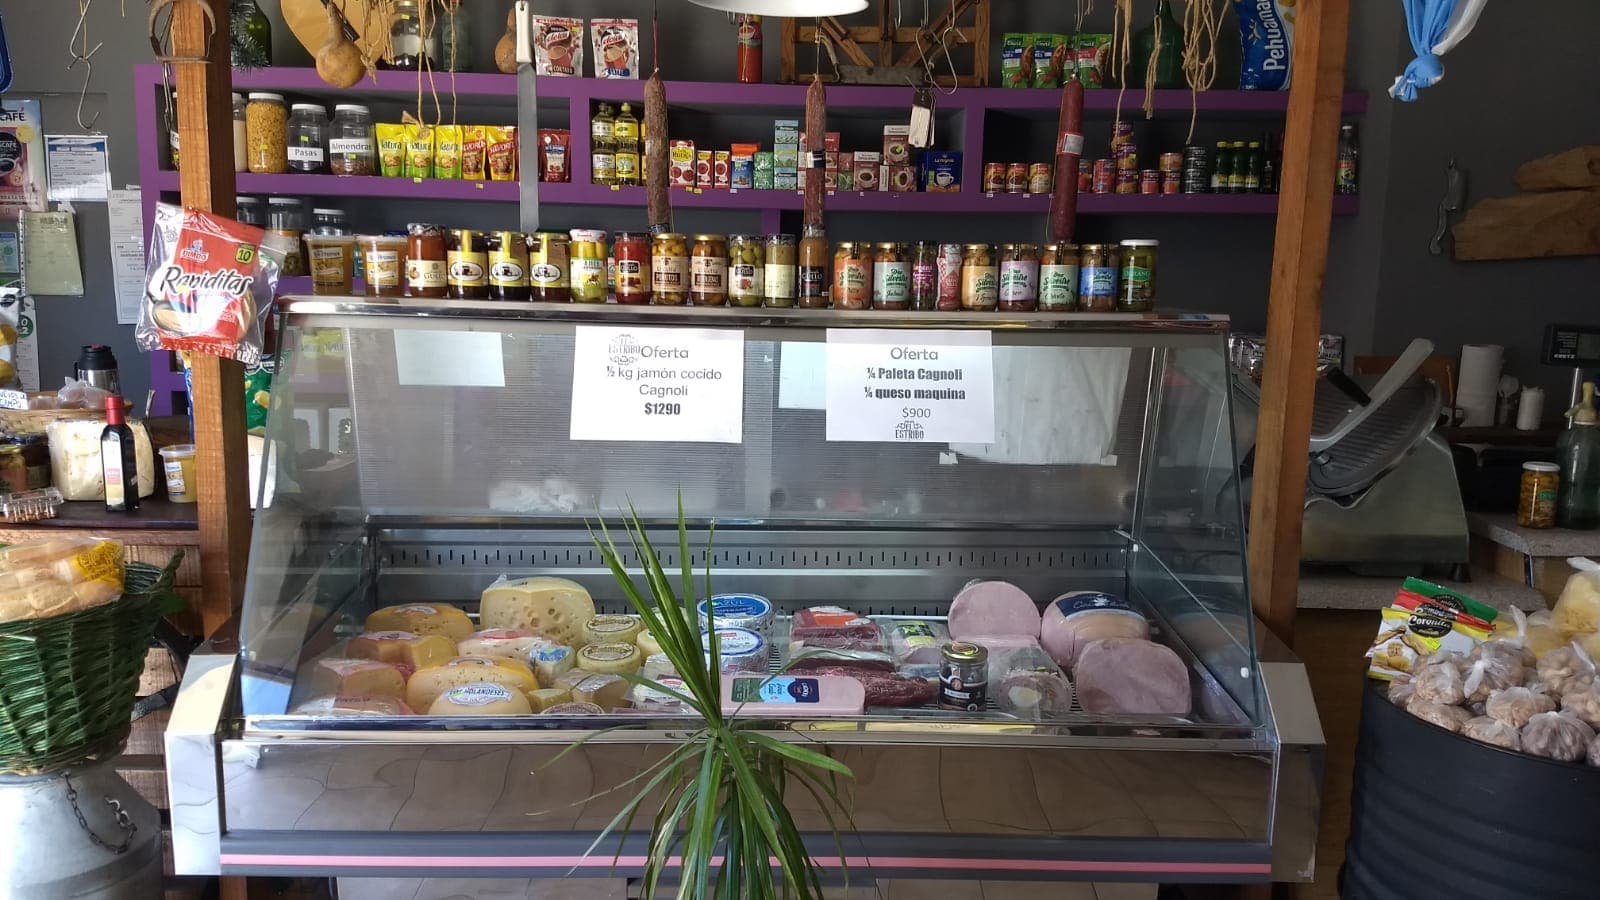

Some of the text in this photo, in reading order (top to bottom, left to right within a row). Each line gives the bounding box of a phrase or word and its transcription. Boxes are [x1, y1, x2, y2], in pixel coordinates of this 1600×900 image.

[1256, 0, 1286, 71] Pehuama
[295, 148, 318, 157] Pasas
[238, 249, 251, 262] 10
[641, 345, 689, 358] Oferta
[890, 346, 939, 360] Oferta
[618, 366, 633, 380] kg
[636, 367, 676, 380] jamón
[680, 368, 722, 380] cocido
[878, 367, 915, 380] Paleta
[917, 368, 963, 381] Cagnoli
[639, 384, 688, 398] Cagnoli
[875, 388, 912, 399] queso
[914, 387, 966, 400] maquina
[644, 402, 681, 416] $1290
[902, 406, 931, 418] $900
[895, 429, 924, 440] ESTRIBO
